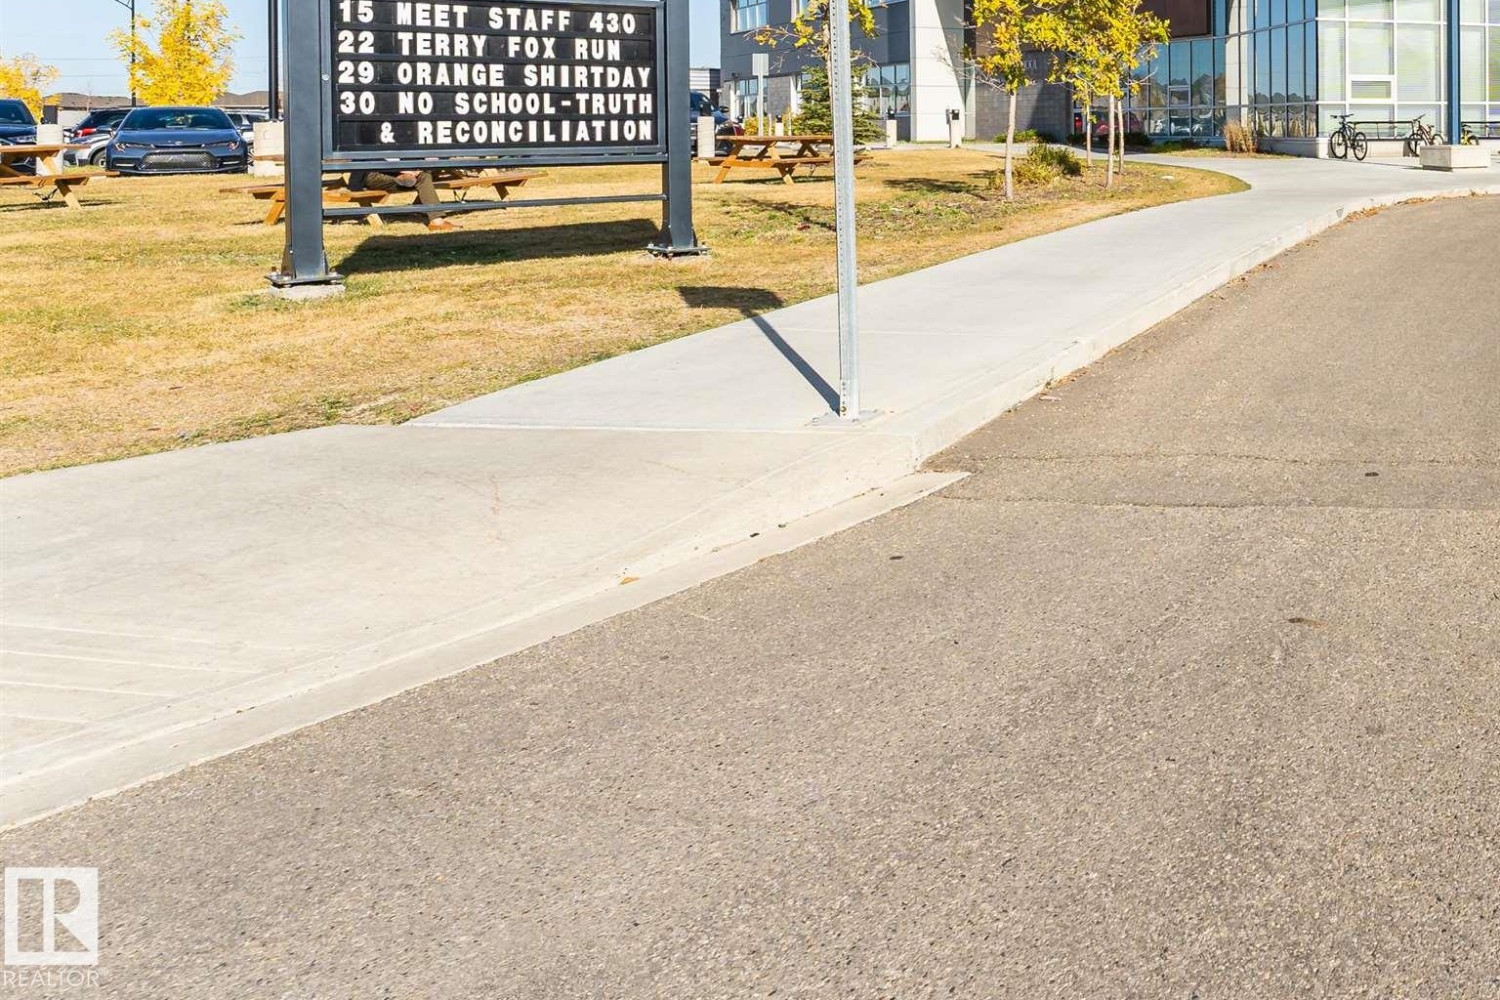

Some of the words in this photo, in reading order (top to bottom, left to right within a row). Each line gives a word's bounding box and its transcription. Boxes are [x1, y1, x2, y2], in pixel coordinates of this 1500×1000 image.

[340, 0, 374, 23] 15
[396, 2, 468, 28] MEET
[488, 7, 571, 32] STAFF
[589, 12, 636, 34] 430
[338, 30, 375, 54] 22
[398, 32, 487, 57] TERRY
[508, 36, 556, 59] FOX
[574, 38, 621, 61] RUN
[338, 61, 375, 84] 29
[397, 62, 505, 87] ORANGE
[524, 64, 650, 88] SHIRTDAY
[340, 91, 376, 115] 30
[398, 91, 433, 115] NO
[380, 122, 396, 143] &
[418, 120, 652, 145] RECONCILIATION
